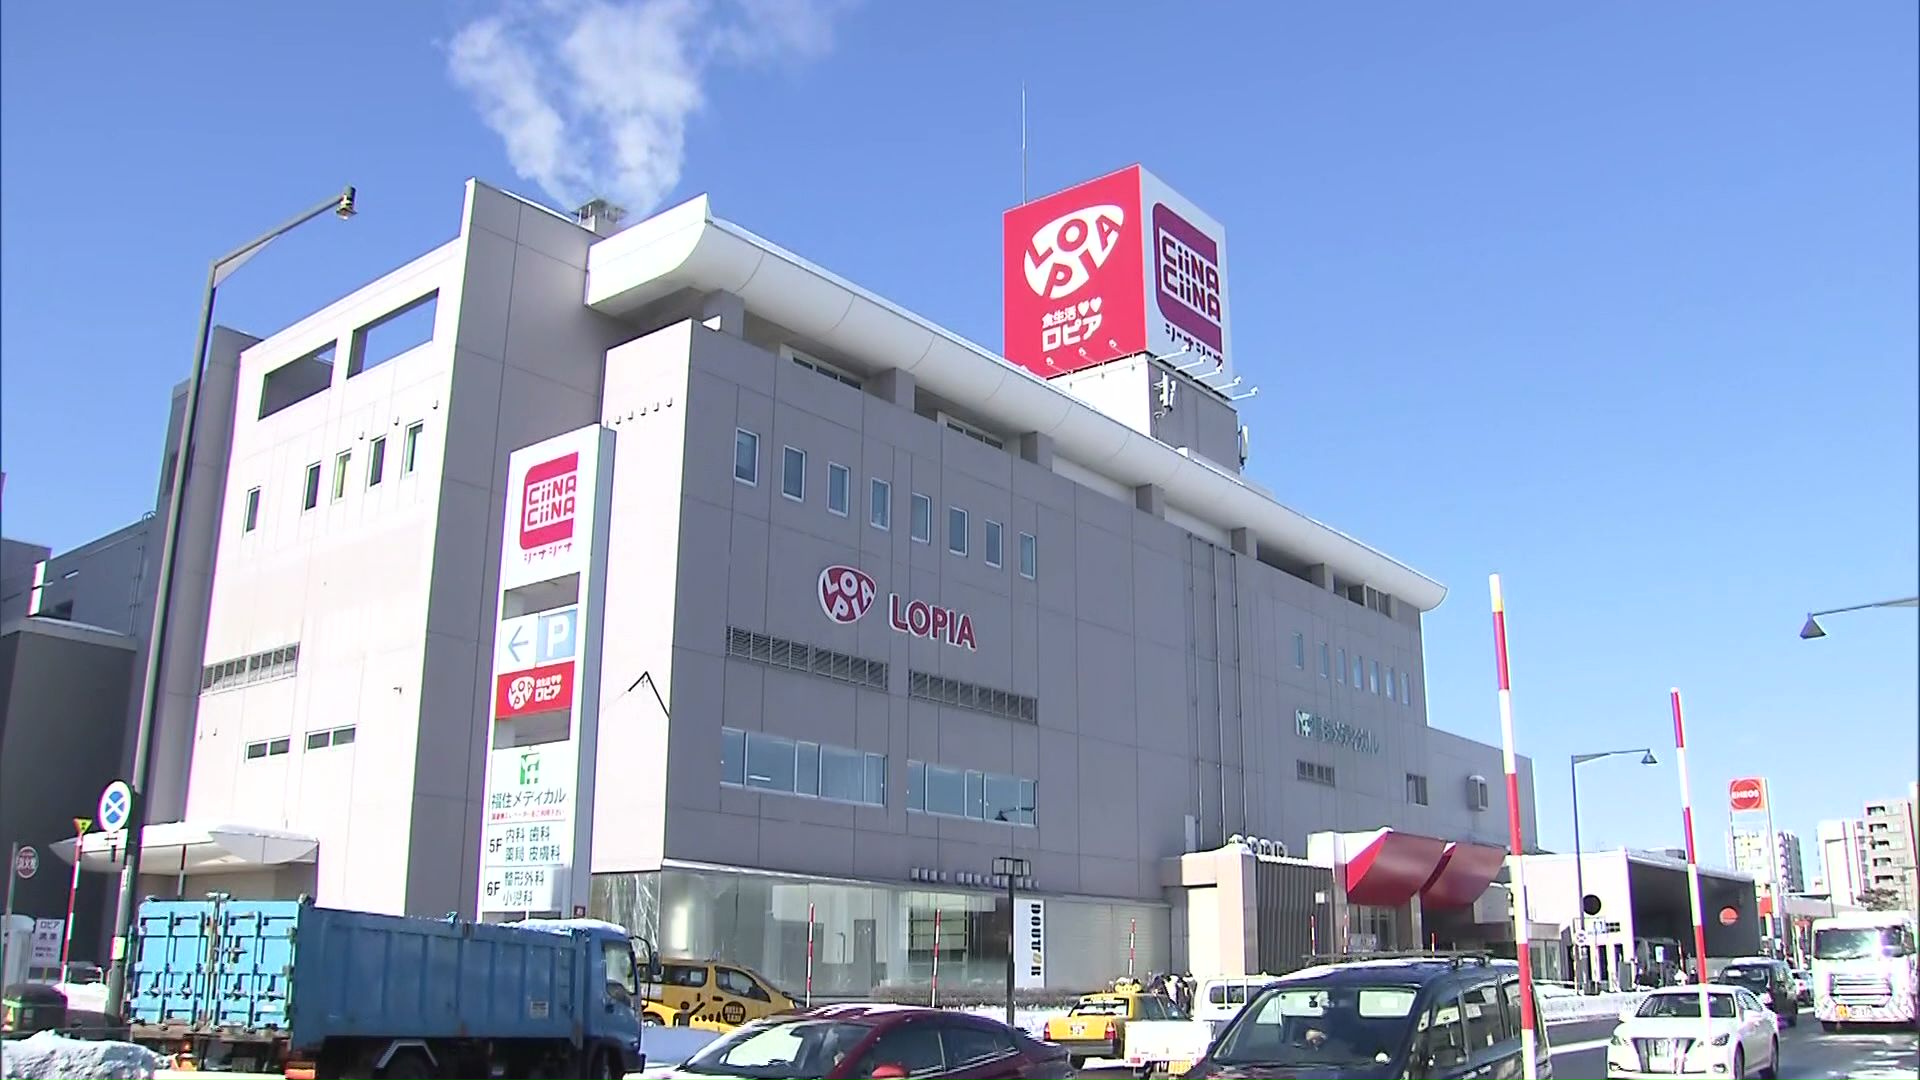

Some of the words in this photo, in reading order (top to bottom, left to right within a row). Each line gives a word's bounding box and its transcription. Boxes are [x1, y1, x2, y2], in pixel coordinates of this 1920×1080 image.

[1042, 305, 1077, 328] 食生活
[1042, 314, 1102, 352] ロピア
[889, 593, 976, 651] LOPIA
[547, 615, 570, 657] P
[1731, 789, 1760, 799] ENEOS
[489, 838, 503, 853] 5F
[505, 827, 525, 843] 内科
[487, 881, 501, 896] 6F
[1031, 904, 1042, 976] DOUTOR
